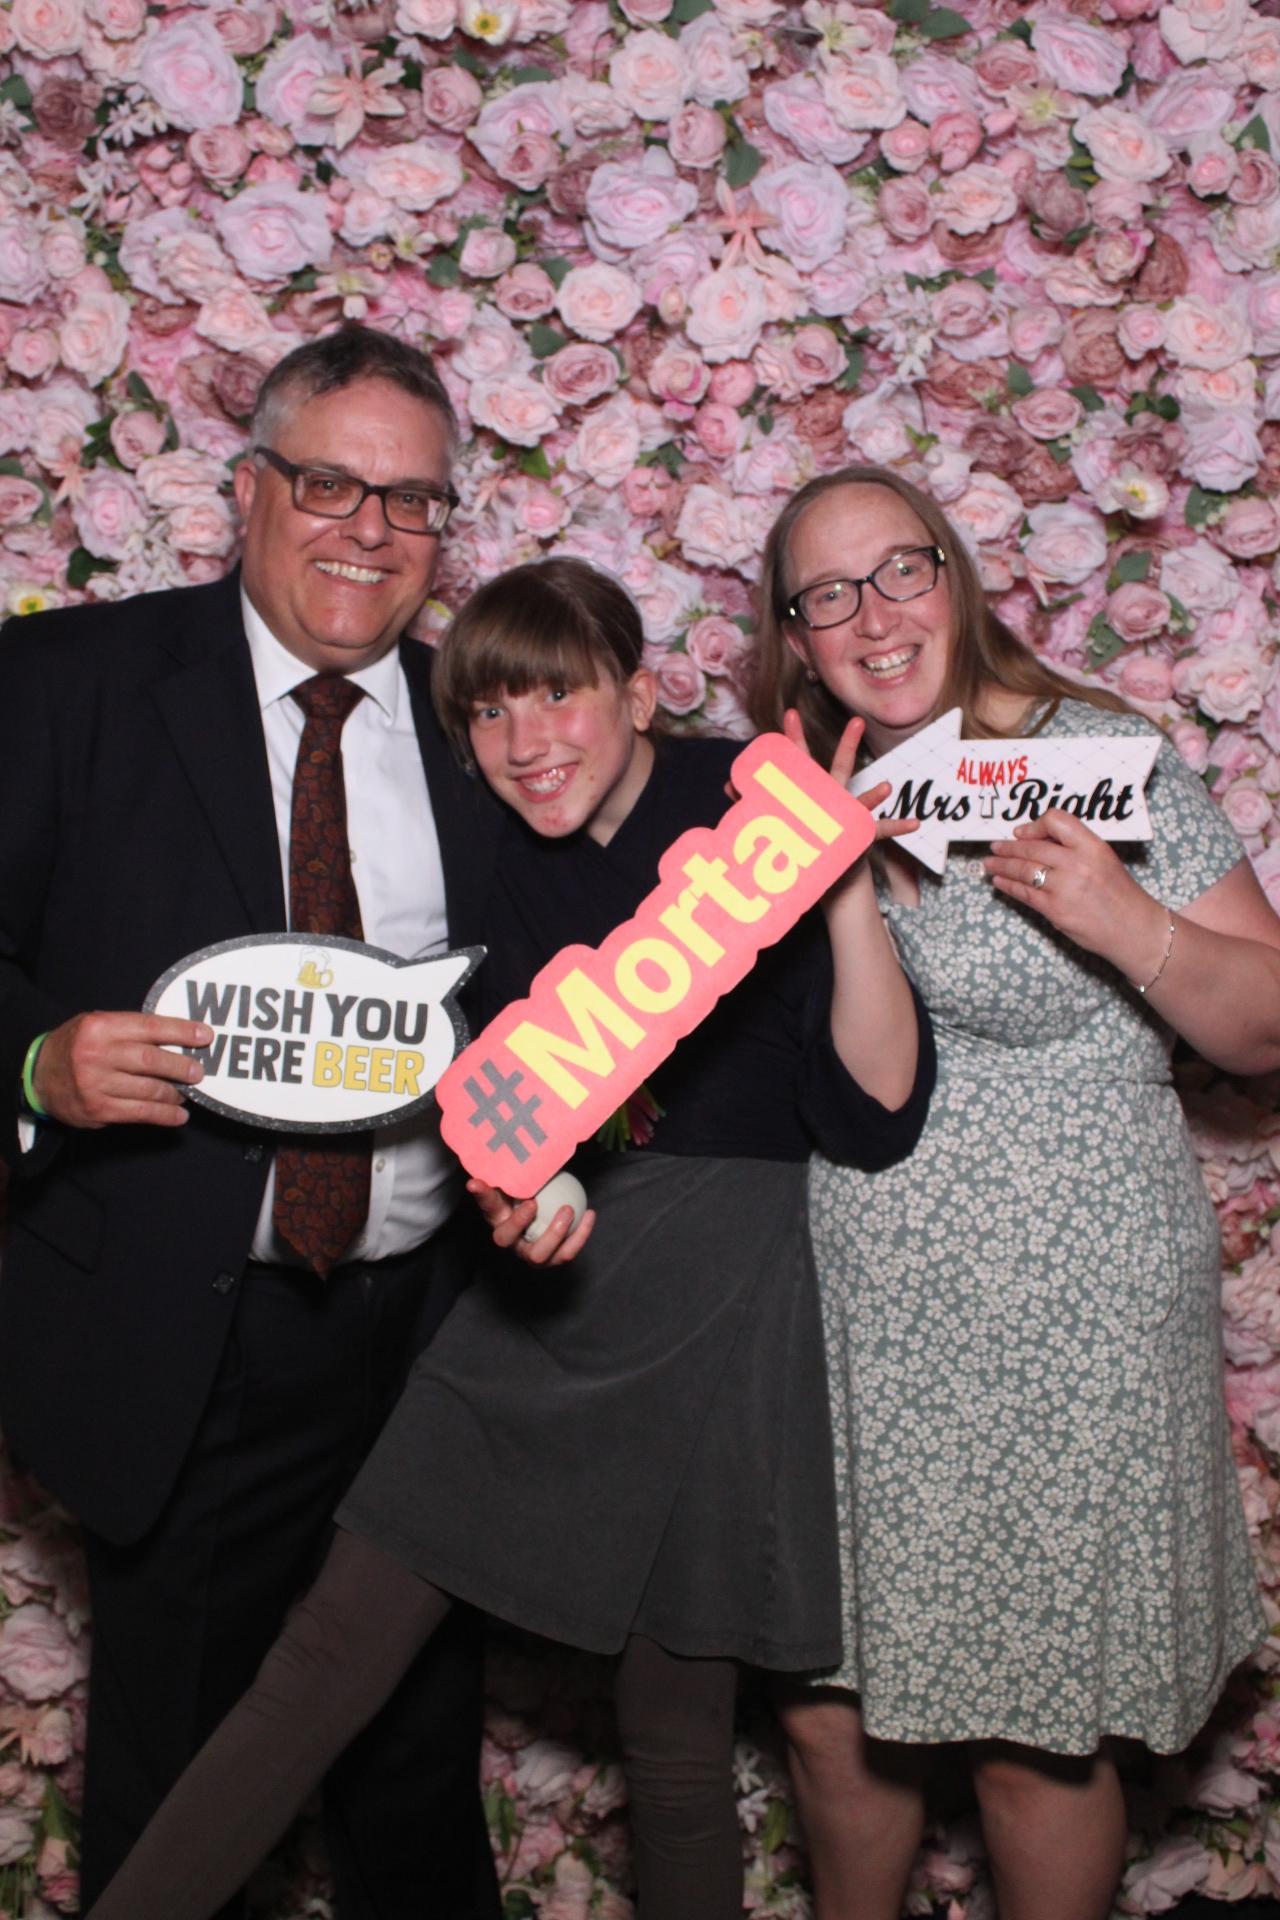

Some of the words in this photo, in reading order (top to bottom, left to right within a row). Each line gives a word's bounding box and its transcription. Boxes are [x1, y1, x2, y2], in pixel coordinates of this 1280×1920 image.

[957, 756, 1029, 786] ALWAYS
[879, 779, 971, 821] Mrs
[462, 760, 844, 1165] #Mortal
[186, 980, 314, 1034] WISH
[325, 993, 429, 1045] YOU
[312, 1041, 425, 1096] BEER
